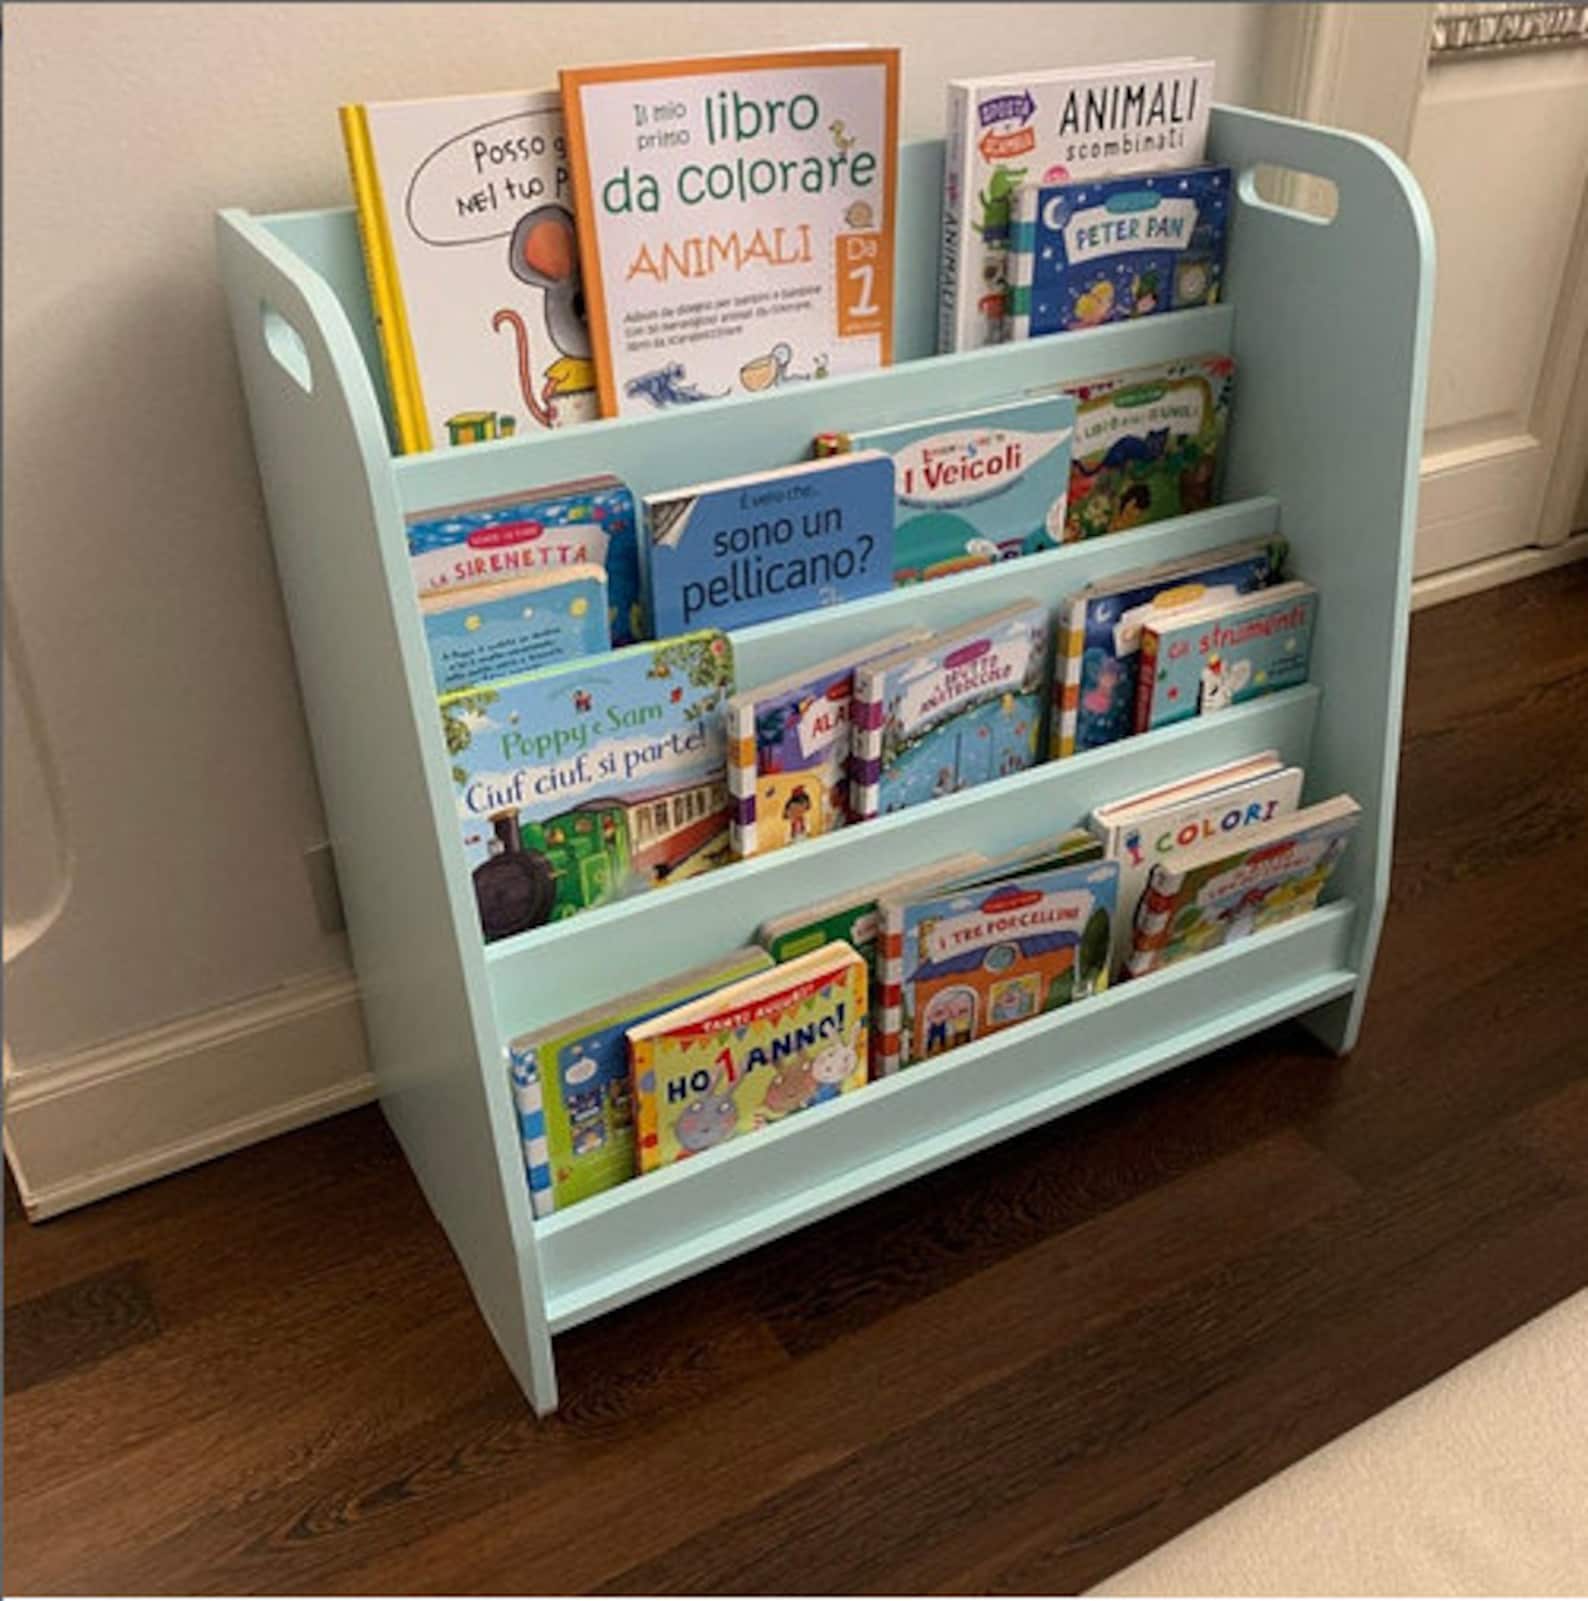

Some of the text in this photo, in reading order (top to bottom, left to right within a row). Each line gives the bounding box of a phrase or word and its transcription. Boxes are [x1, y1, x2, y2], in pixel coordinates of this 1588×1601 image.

[652, 100, 687, 122] mio
[704, 90, 819, 146] libro
[1058, 78, 1199, 138] ANIMALI
[636, 126, 690, 151] primo
[1065, 128, 1186, 162] scombinati
[504, 176, 545, 202] tuo
[602, 151, 877, 214] da colorare
[625, 224, 813, 282] ANIMALI
[1076, 216, 1187, 250] PETER PAN
[848, 264, 881, 318] 1
[903, 468, 913, 494] I
[923, 443, 1022, 490] Veicoli
[713, 507, 843, 558] sono un
[453, 546, 588, 580] SIRENETTA
[681, 534, 875, 625] pellicano?
[502, 722, 589, 760] Poppy
[605, 703, 664, 730] Sam
[465, 721, 707, 814] Ciuf ciuf, si parte!
[1155, 799, 1280, 854] COLORI
[666, 1002, 847, 1104] HO 1 ANNO!
